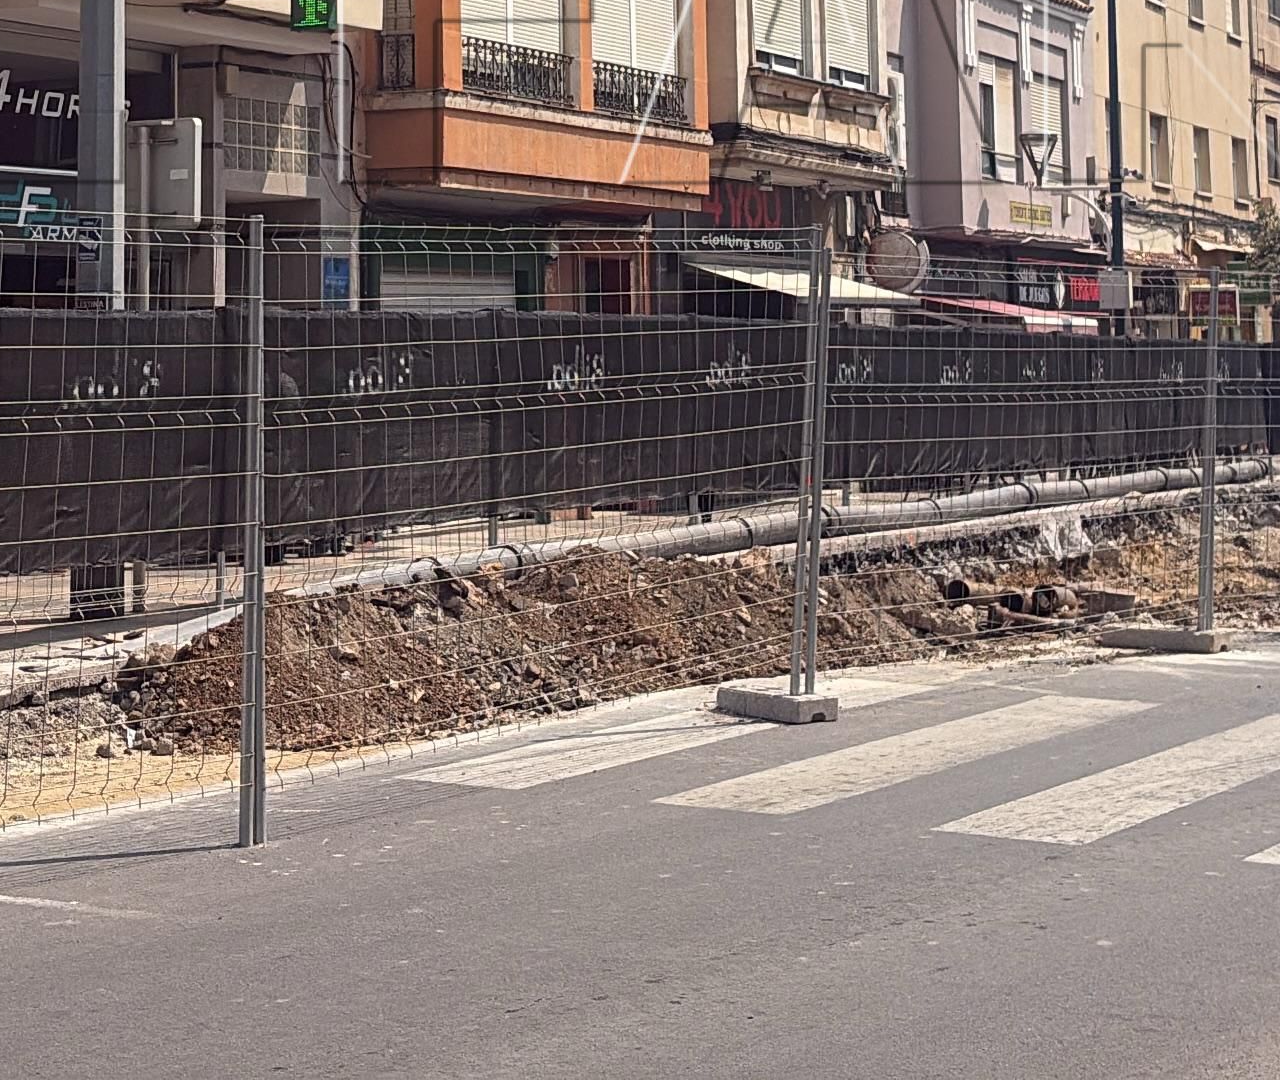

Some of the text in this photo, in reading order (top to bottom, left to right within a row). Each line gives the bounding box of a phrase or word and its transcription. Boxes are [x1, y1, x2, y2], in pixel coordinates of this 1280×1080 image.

[726, 182, 782, 231] YOU
[701, 232, 782, 252] clothing shop
